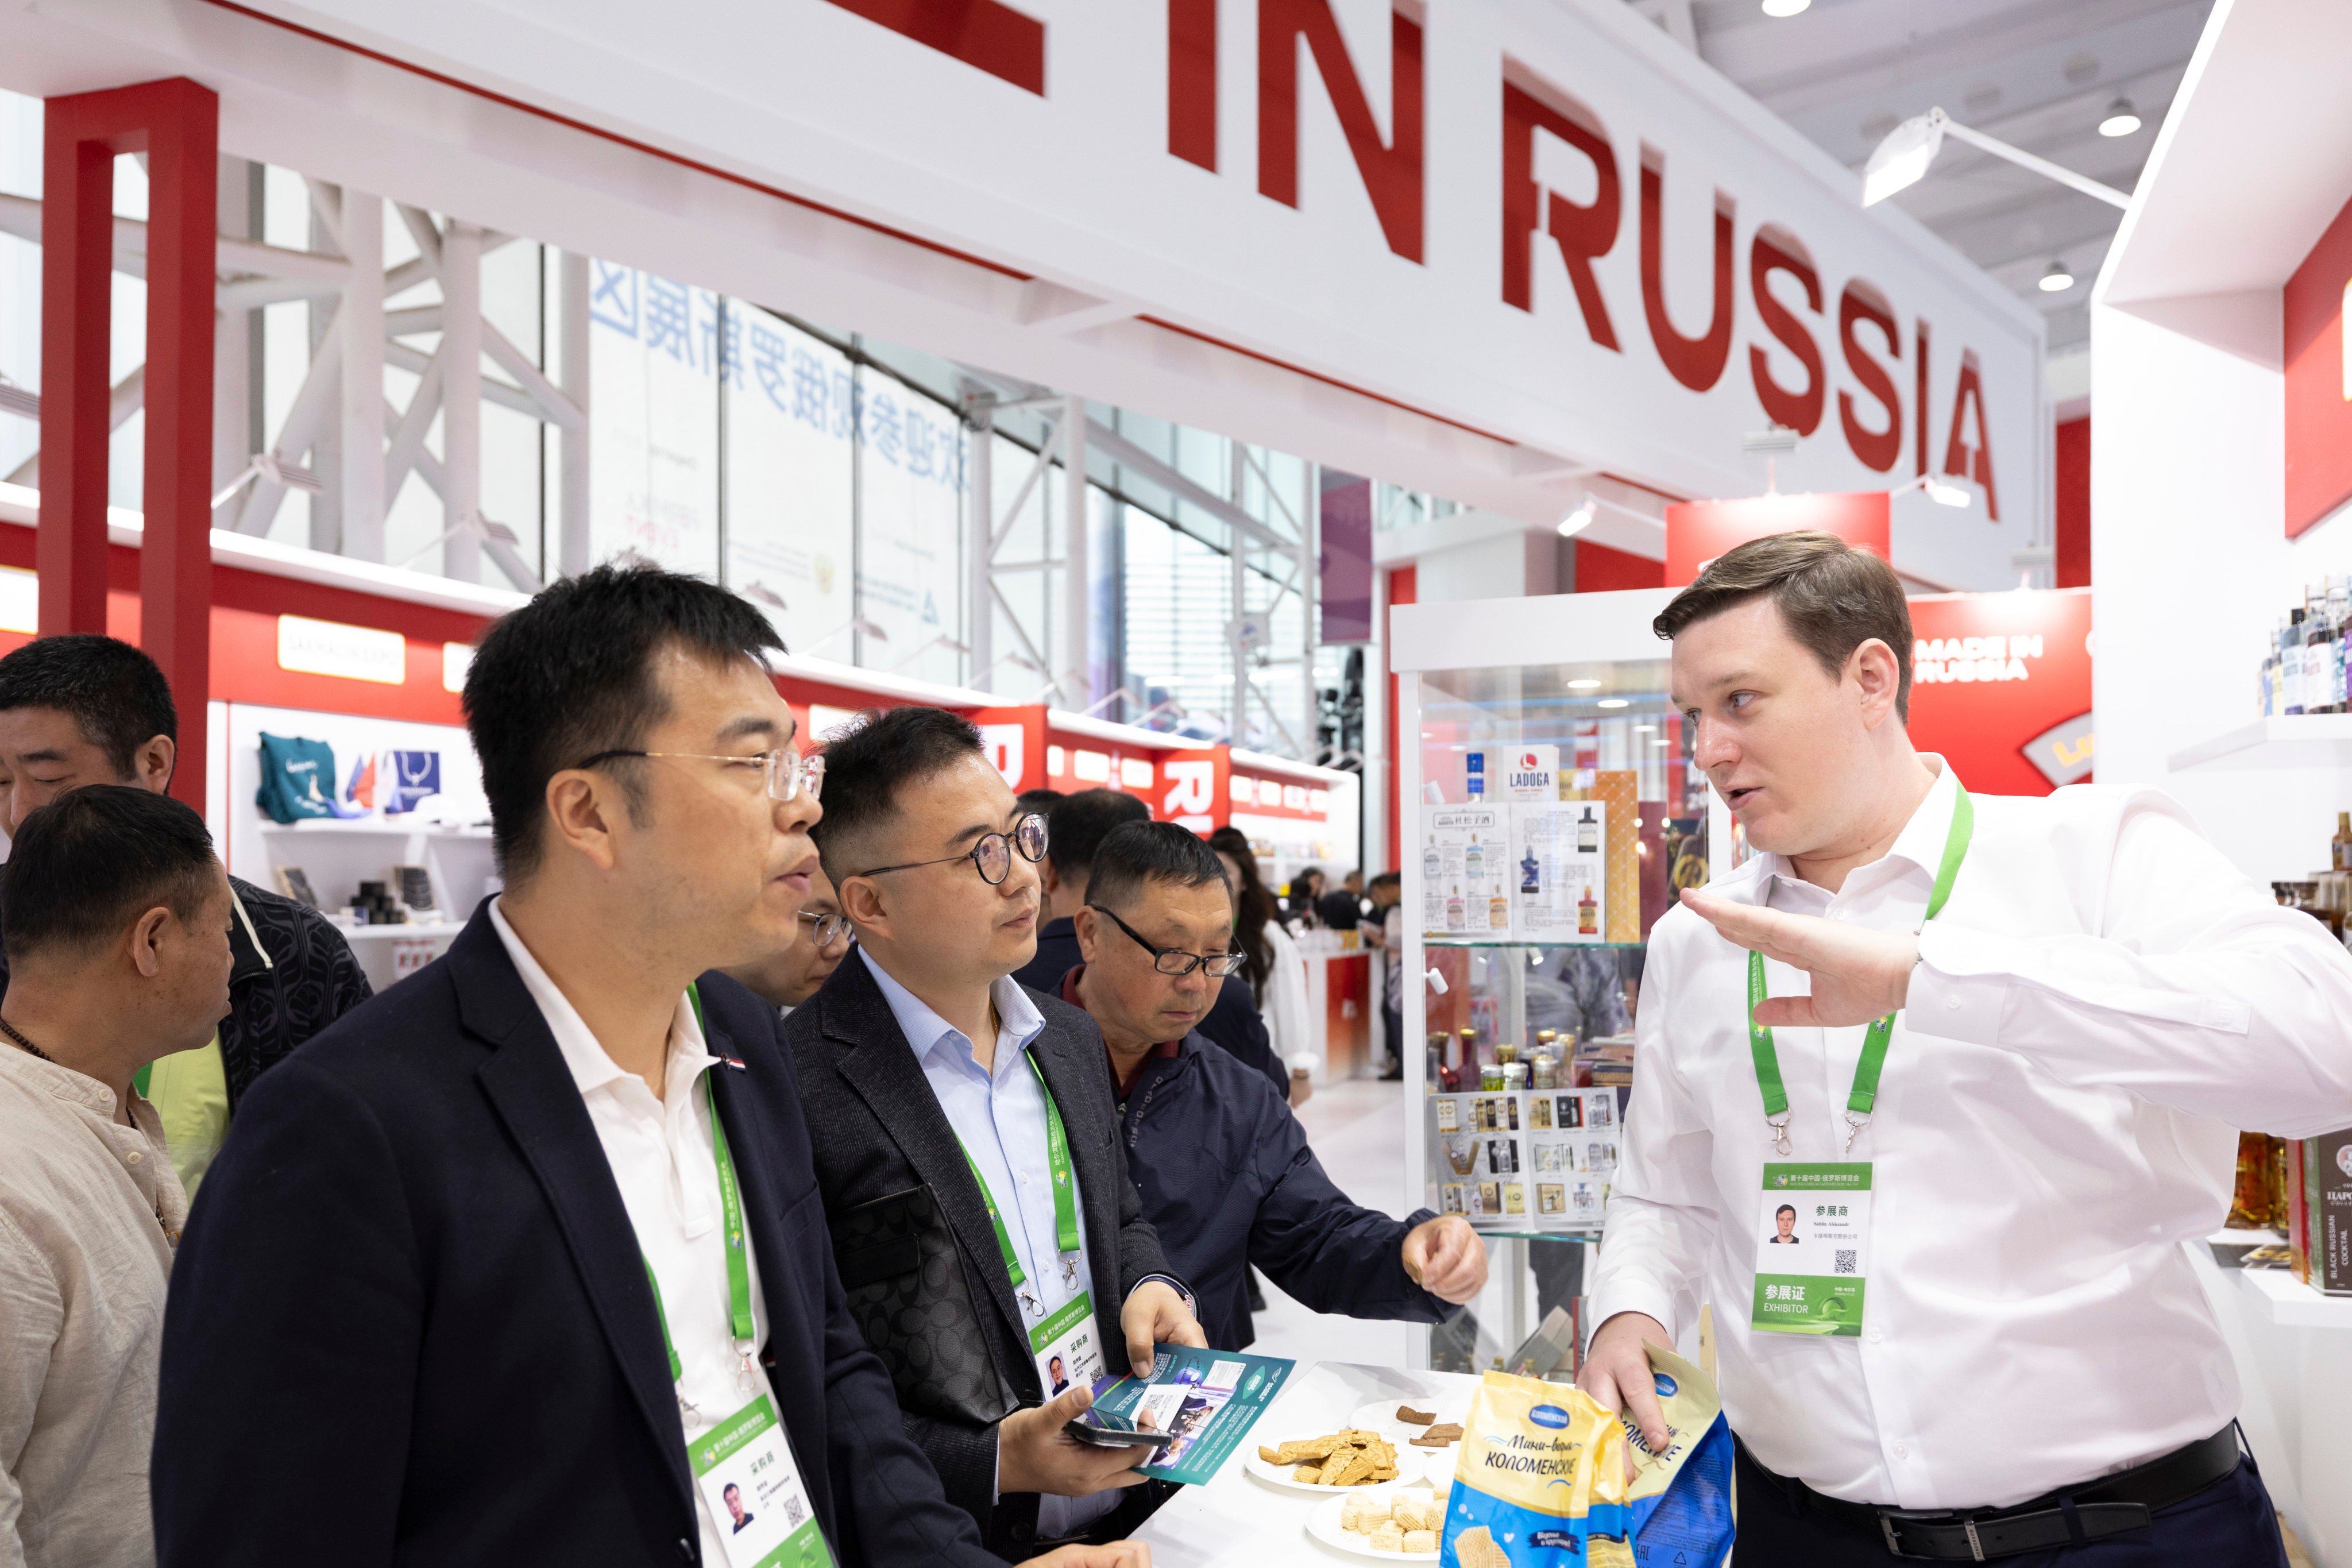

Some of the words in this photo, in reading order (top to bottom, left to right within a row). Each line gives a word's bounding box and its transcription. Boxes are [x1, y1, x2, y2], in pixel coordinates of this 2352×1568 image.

[1502, 51, 2000, 523] RUSSIA
[1914, 636, 2007, 661] MADE
[2010, 634, 2044, 659] IN
[1914, 658, 2029, 683] RUSSIA
[1509, 772, 1550, 787] LADOGA
[1455, 815, 1490, 825] 杜松子酒
[1816, 1205, 1849, 1216] 参展商
[2328, 1215, 2337, 1249] RUSSIAN
[2340, 1229, 2349, 1266] COCKTAIL
[2330, 1250, 2338, 1279] BLACK
[1766, 1284, 1805, 1301] 参展证
[1764, 1303, 1809, 1314] EXHIBITOR
[1070, 1333, 1089, 1354] 采购商
